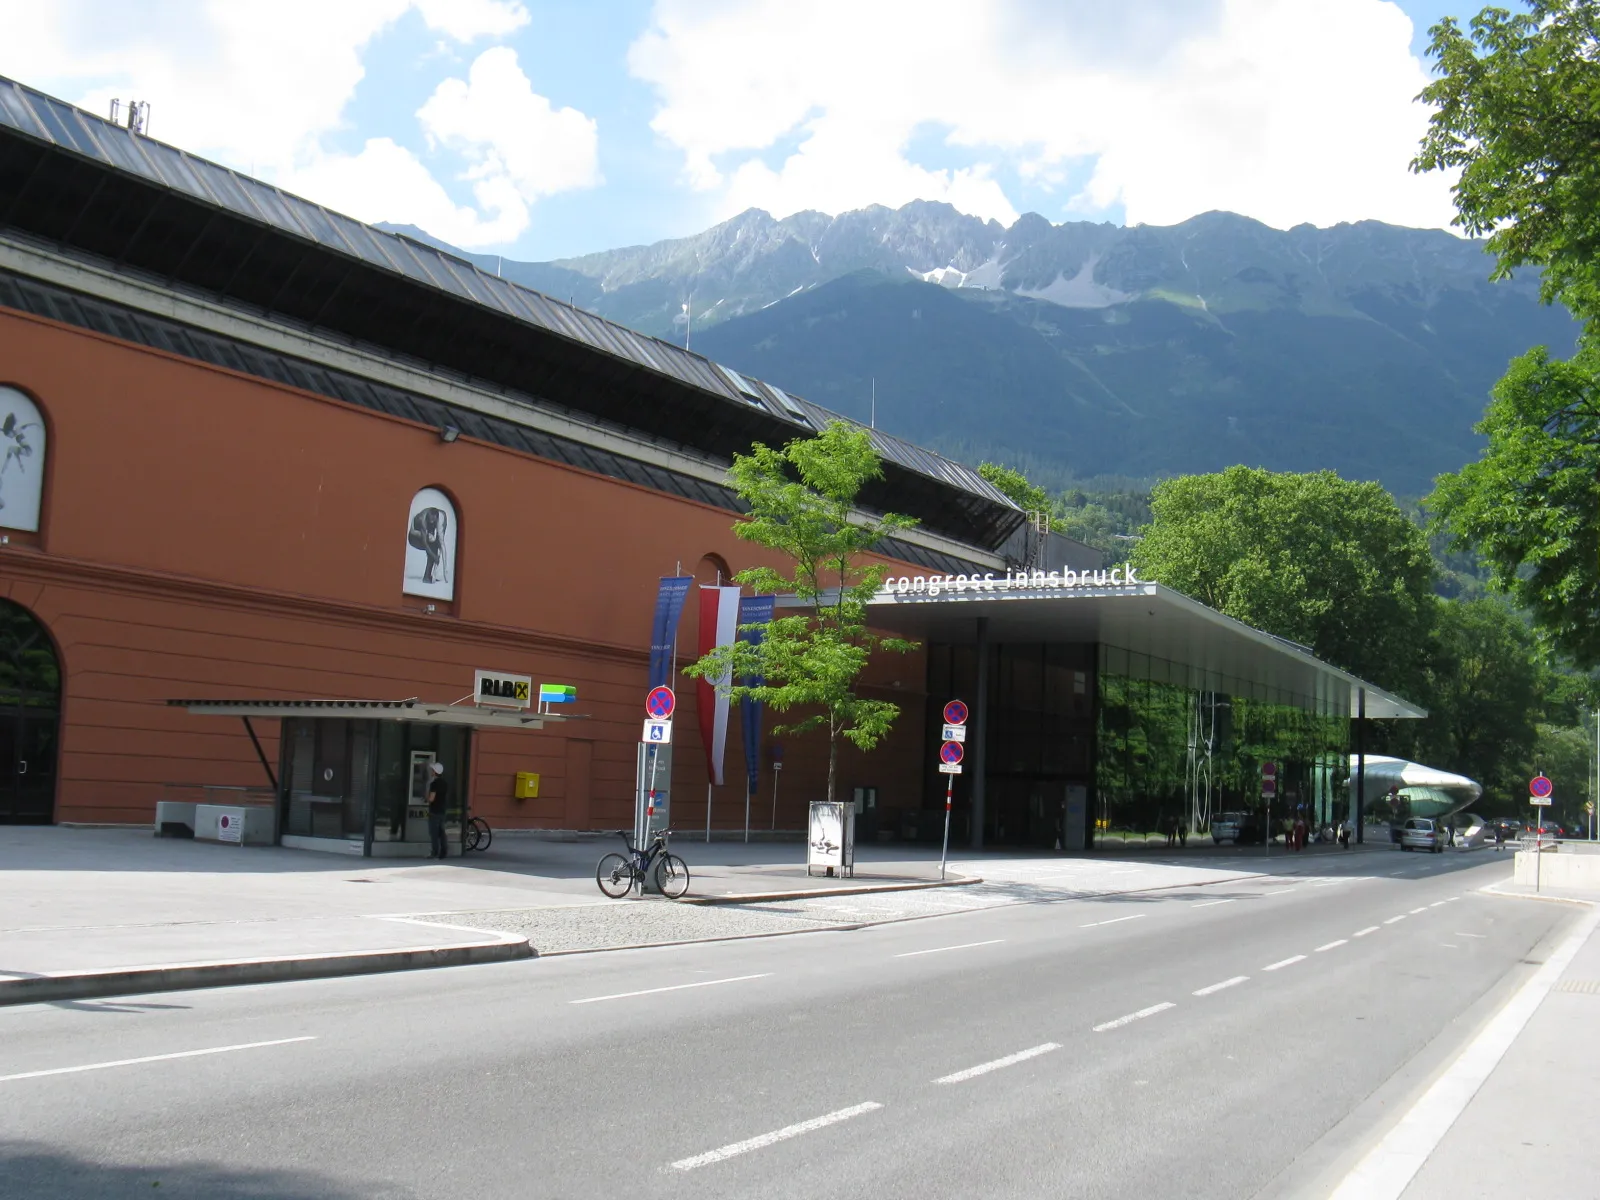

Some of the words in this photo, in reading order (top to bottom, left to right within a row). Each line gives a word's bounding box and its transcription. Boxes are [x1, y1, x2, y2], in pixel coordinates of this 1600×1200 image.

[885, 570, 995, 596] congress
[1006, 562, 1139, 589] innsbruck
[481, 678, 515, 698] RLB
